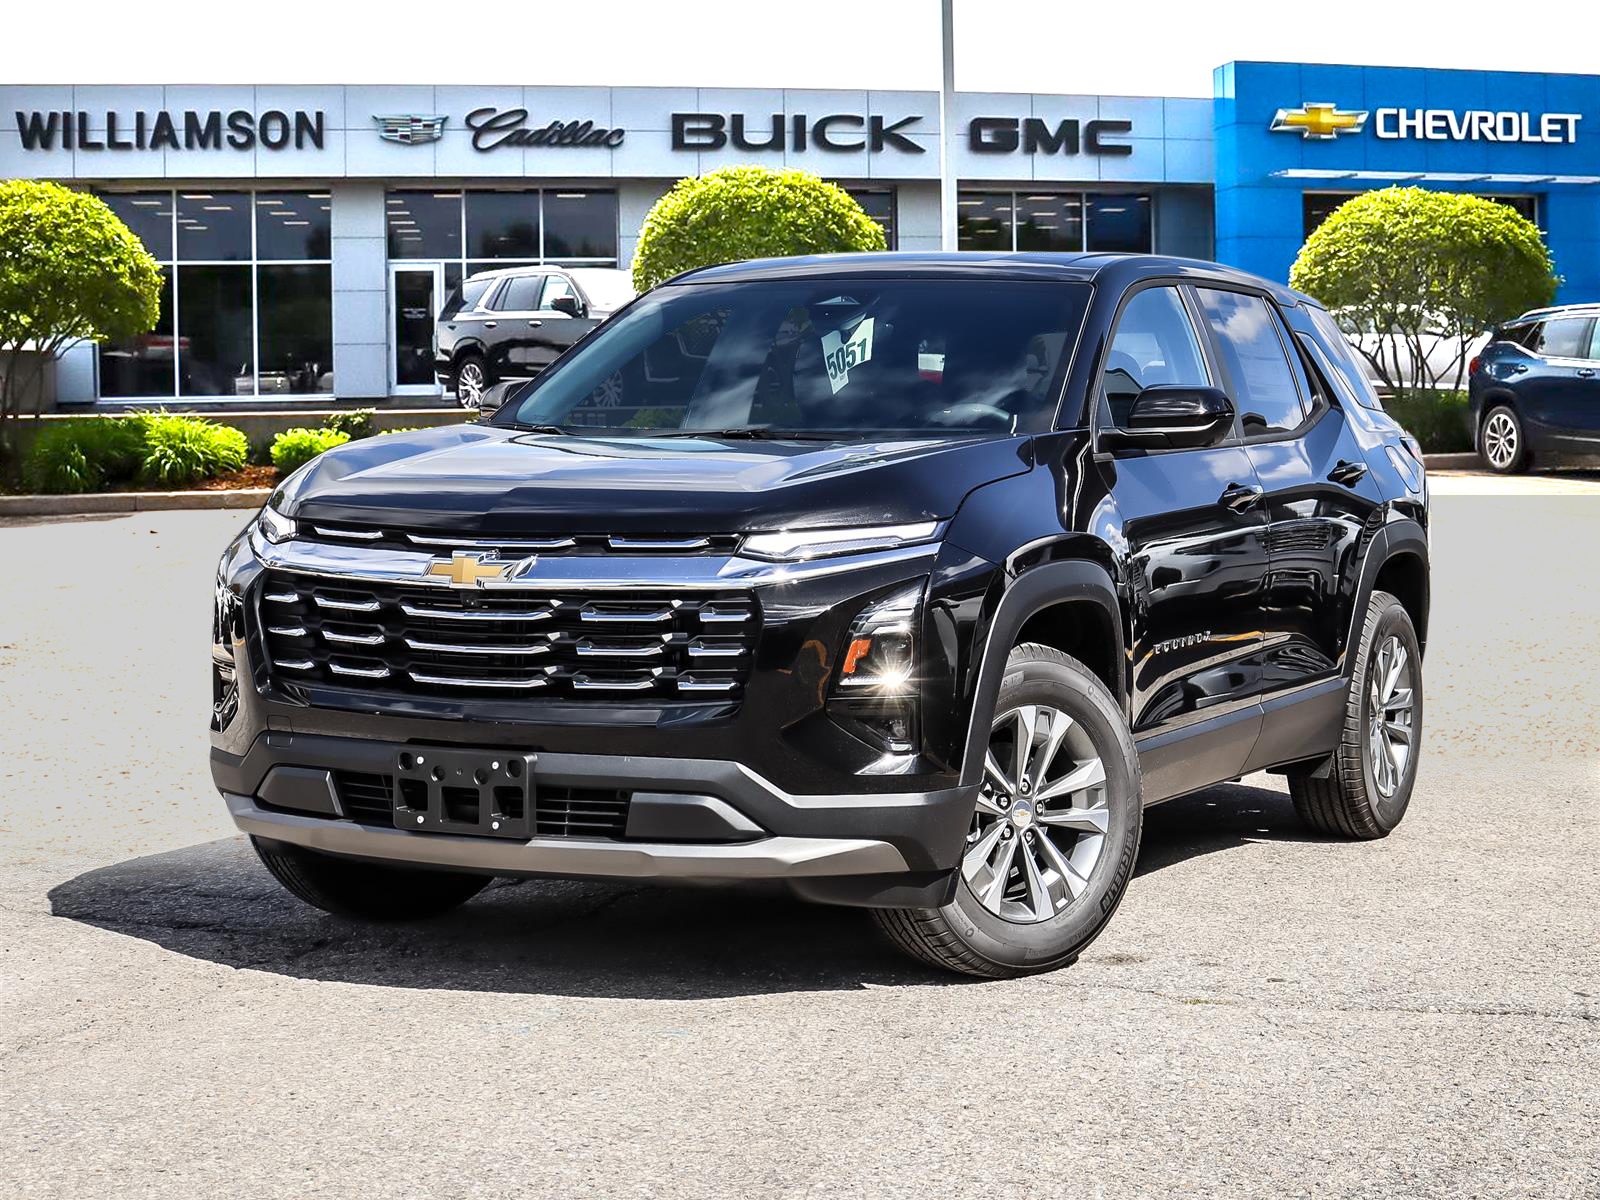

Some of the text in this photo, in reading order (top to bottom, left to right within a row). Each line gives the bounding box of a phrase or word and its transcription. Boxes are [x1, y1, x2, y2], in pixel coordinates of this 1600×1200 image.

[15, 110, 325, 150] WILLIAMSON
[465, 107, 626, 151] Cadillac
[671, 113, 926, 152] BUICK
[968, 116, 1133, 156] GMC
[1376, 108, 1582, 143] CHEVROLET
[826, 338, 867, 380] 5051
[1100, 829, 1136, 914] MICHELIN
